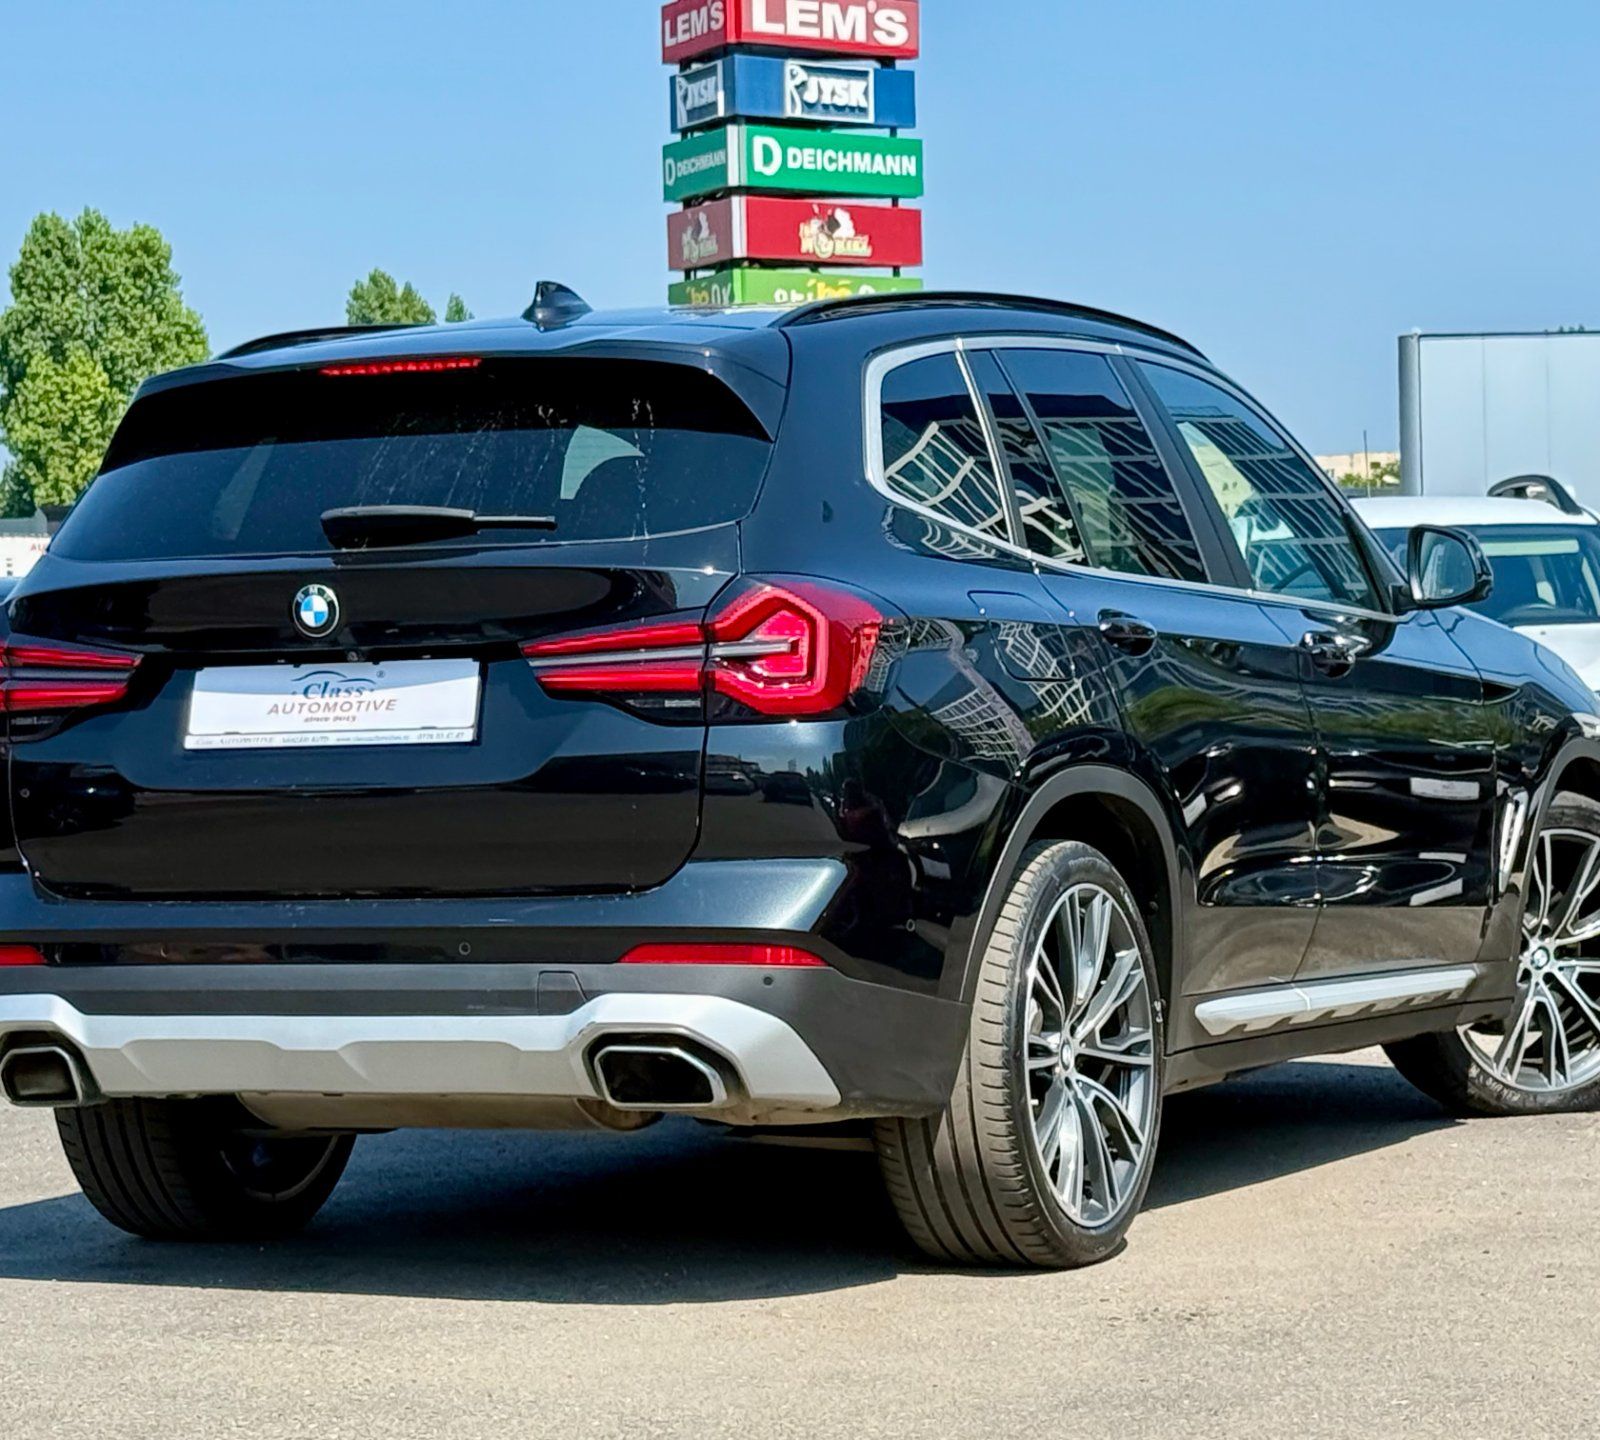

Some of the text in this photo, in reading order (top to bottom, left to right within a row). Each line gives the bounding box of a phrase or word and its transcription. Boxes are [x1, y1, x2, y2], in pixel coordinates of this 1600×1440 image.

[664, 0, 725, 47] LEM'S
[751, 0, 909, 46] LEM'S
[685, 76, 718, 111] JYSK
[803, 75, 868, 108] JYSK
[676, 149, 726, 177] DEICHMANN
[786, 147, 917, 176] DEICHMANN
[302, 681, 365, 700] Class
[267, 699, 398, 715] AUTOMOTIVE
